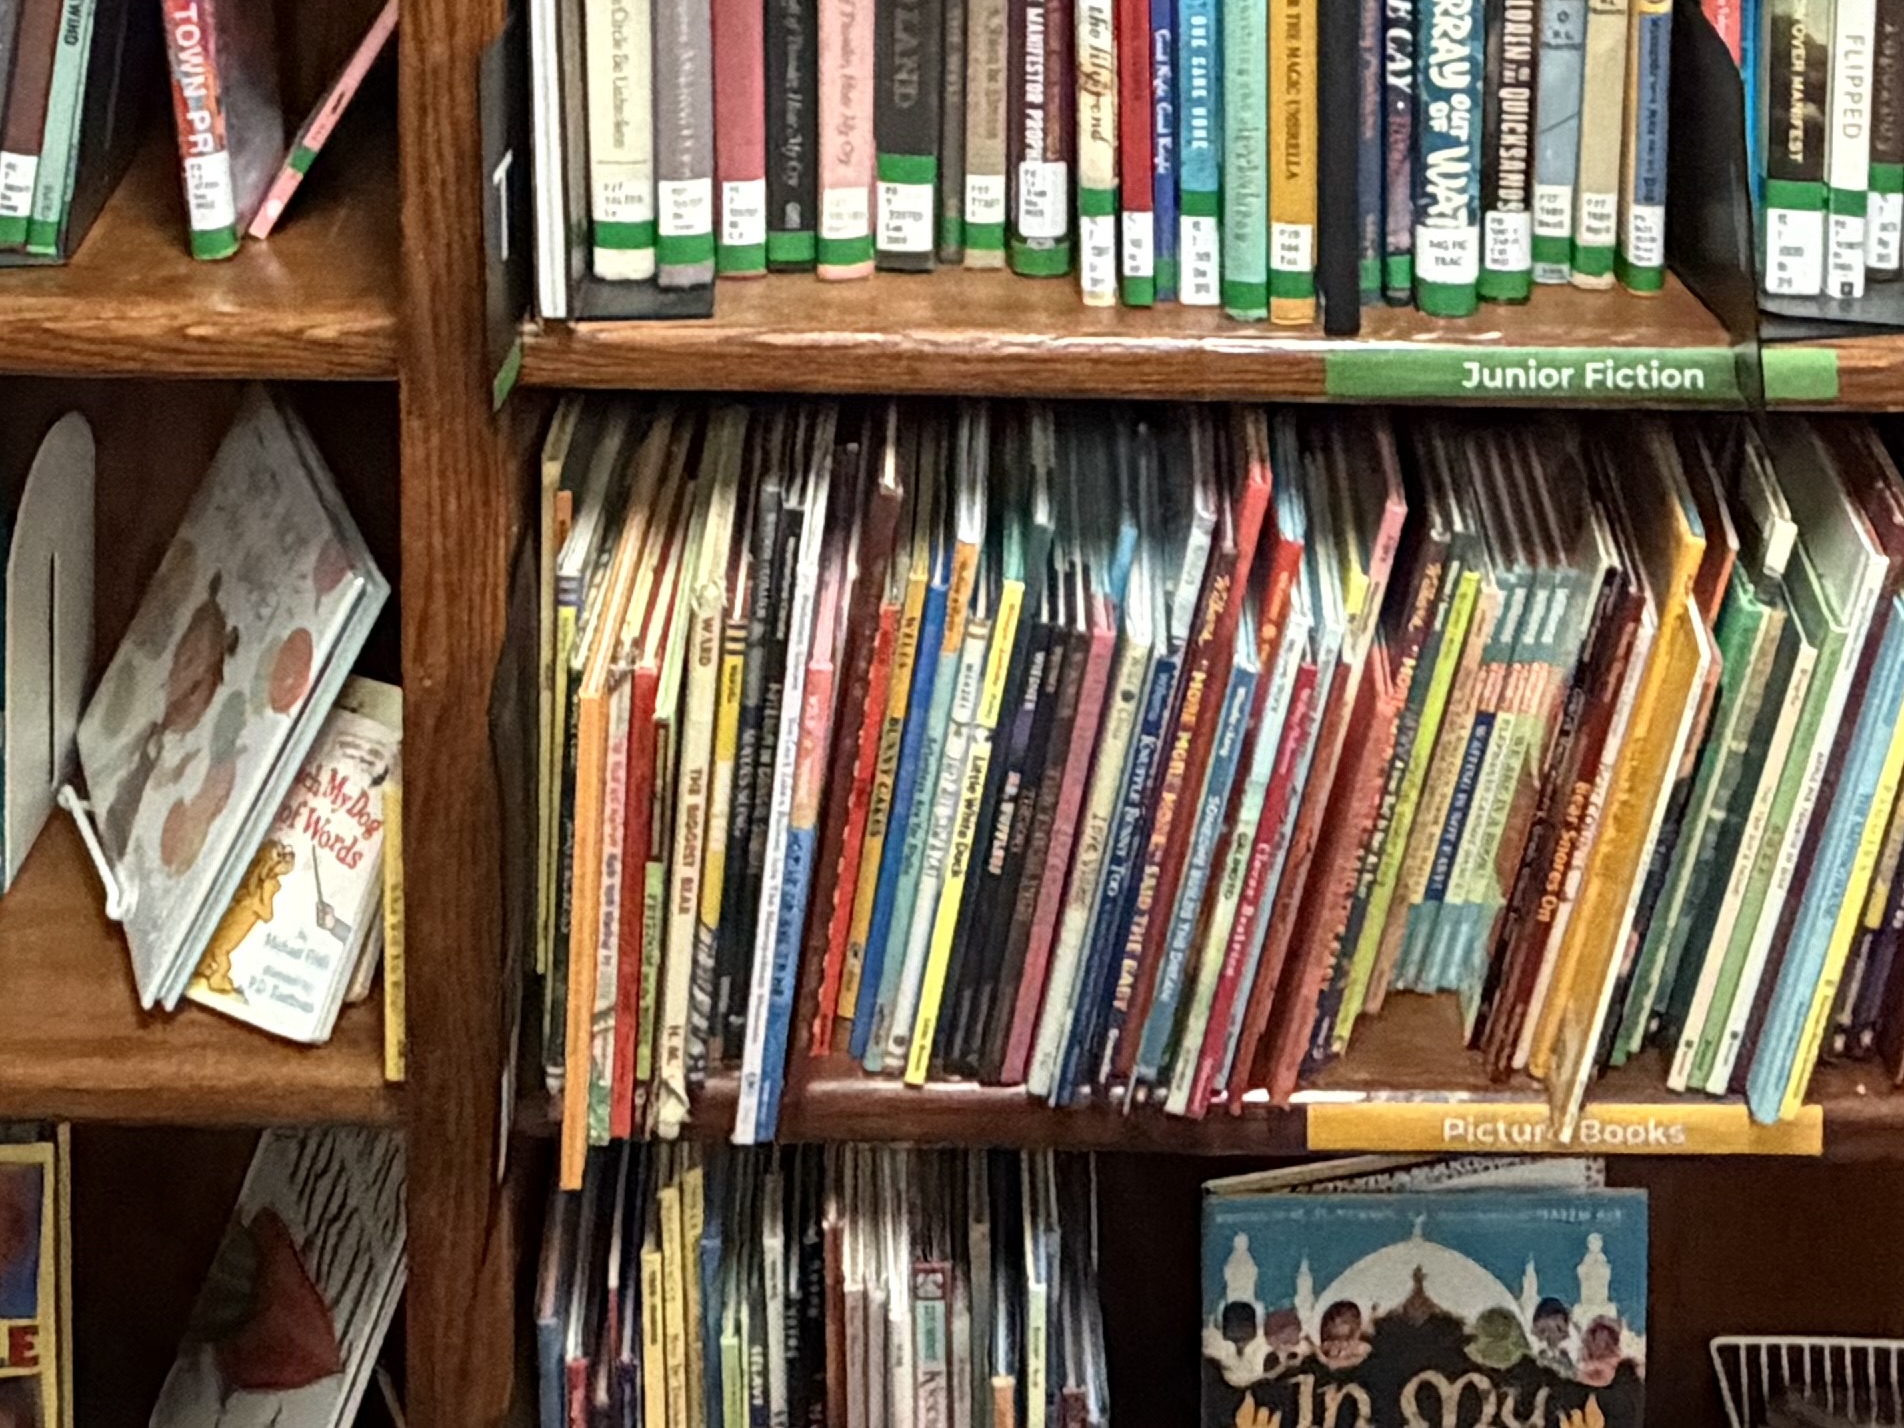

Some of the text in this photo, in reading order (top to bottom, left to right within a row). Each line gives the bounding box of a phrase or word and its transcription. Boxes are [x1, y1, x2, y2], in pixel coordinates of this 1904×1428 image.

[175, 1, 208, 88] TOWN
[1385, 27, 1412, 94] CAY
[1842, 34, 1865, 140] FLIPPED
[1428, 101, 1447, 134] OF
[1450, 94, 1470, 140] OUT
[1462, 360, 1705, 390] Junior Fiction
[1579, 1117, 1686, 1144] Books
